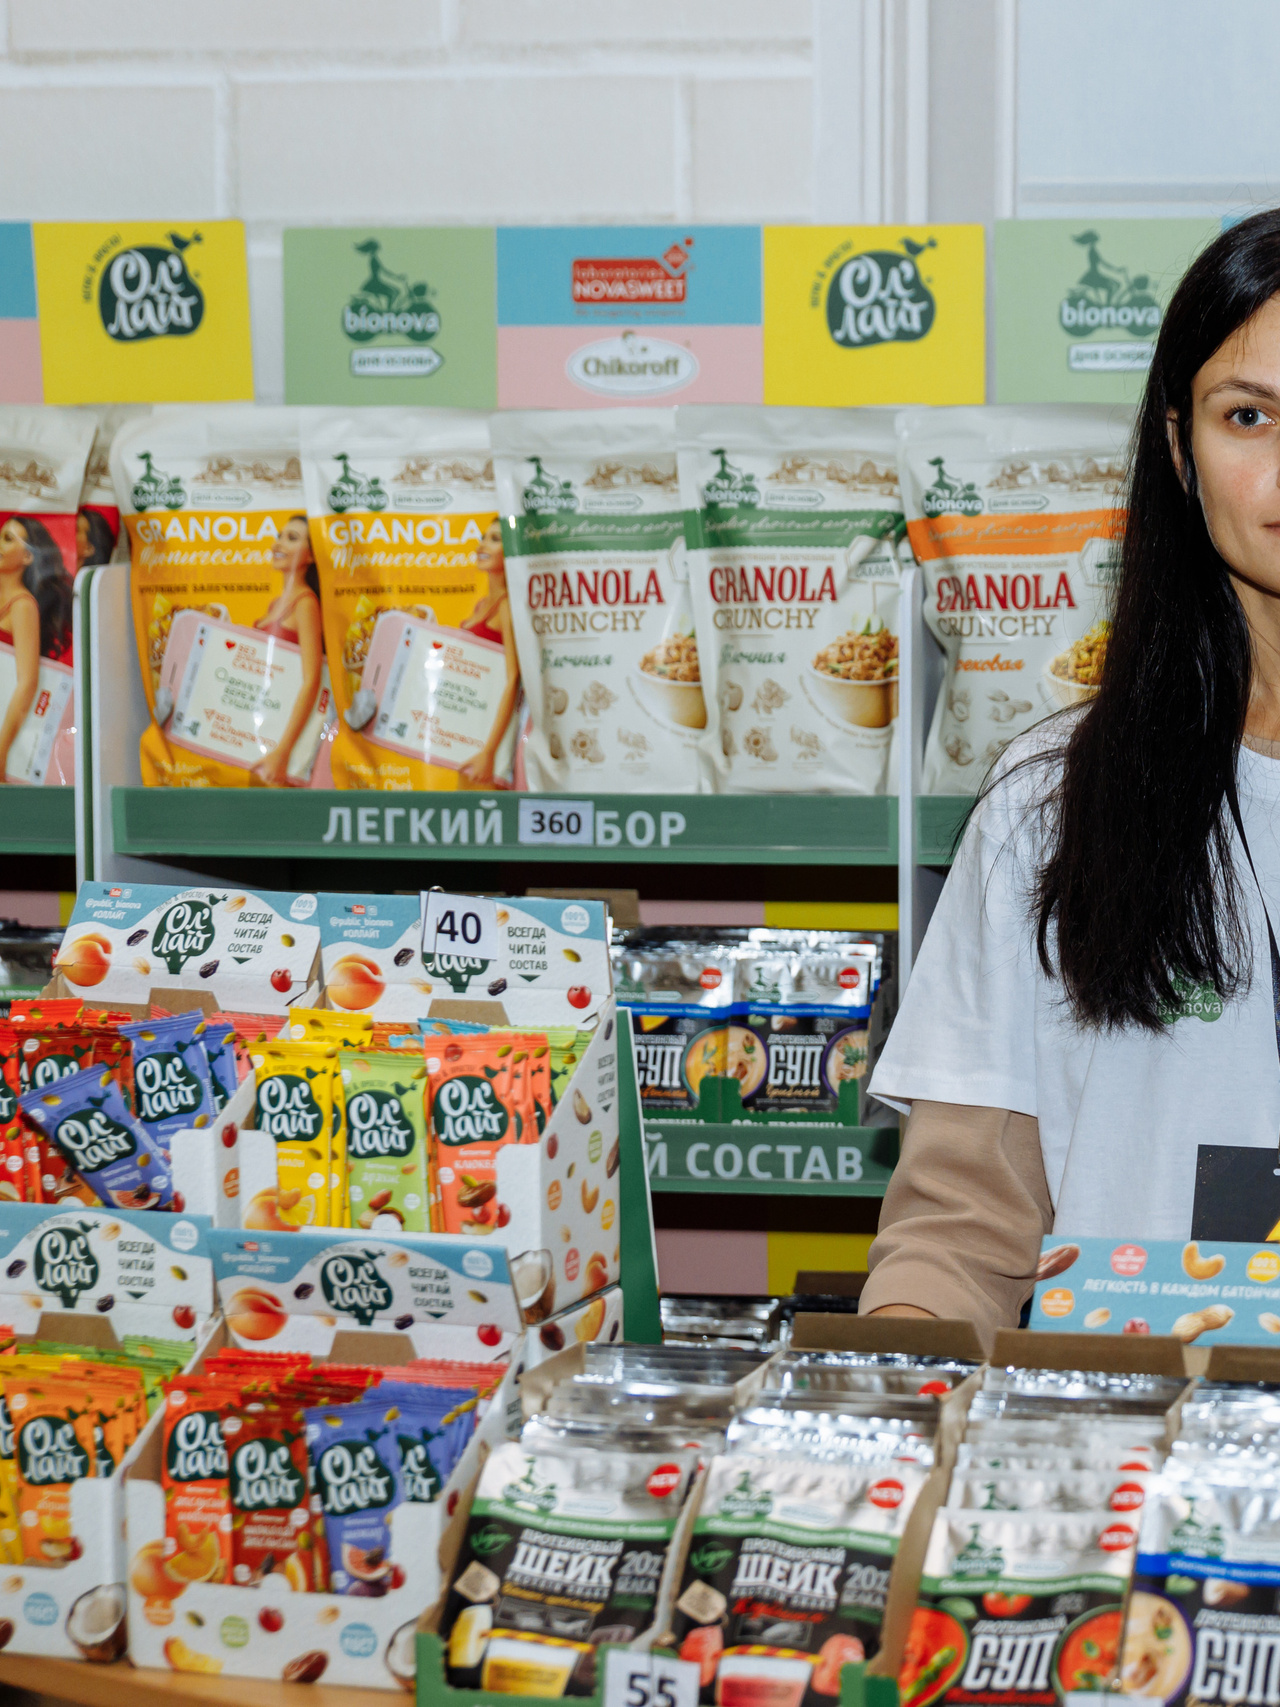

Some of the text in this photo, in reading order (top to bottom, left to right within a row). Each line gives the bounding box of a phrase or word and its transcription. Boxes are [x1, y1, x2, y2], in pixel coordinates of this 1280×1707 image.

[573, 279, 686, 301] NOVASWEET
[345, 305, 440, 333] bionova
[1061, 300, 1161, 328] bionova
[583, 356, 679, 377] Chikoroff
[136, 516, 279, 545] GRANOLA
[330, 518, 483, 546] GRANOLA
[528, 568, 665, 609] GRANOLA
[709, 566, 838, 603] GRANOLA
[936, 571, 1078, 613] GRANOLA
[531, 610, 647, 636] CRUNCHY
[712, 607, 820, 630] CRUNCHY
[937, 614, 1057, 639] CRUNCHY
[323, 799, 503, 844] ЛЕГКИЙ
[531, 810, 582, 835] 360
[238, 912, 273, 924] ВСЕГДА
[437, 909, 483, 945] 40
[153, 931, 212, 954] лайт
[234, 926, 269, 940] ЧИТАЙ
[507, 926, 546, 940] ВСЕГДА
[228, 942, 263, 954] СОСТАВ
[509, 941, 546, 955] ЧИТАЙ
[509, 960, 547, 971] СОСТАВ
[768, 1046, 824, 1086] СУП
[140, 1084, 197, 1118] лайт
[440, 1110, 504, 1142] лайт
[686, 1143, 864, 1181] СОСТАВ
[1083, 1278, 1148, 1296] ЛЕГКОСТЬ
[1151, 1283, 1160, 1295] В
[1161, 1281, 1218, 1298] КАЖДОМ
[649, 1472, 681, 1487] NEW
[510, 1543, 620, 1587] ШЕЙК
[618, 1551, 664, 1577] 20%
[735, 1553, 843, 1598] ШЕЙК
[962, 1631, 1060, 1691] СУП
[627, 1673, 677, 1707] 55
